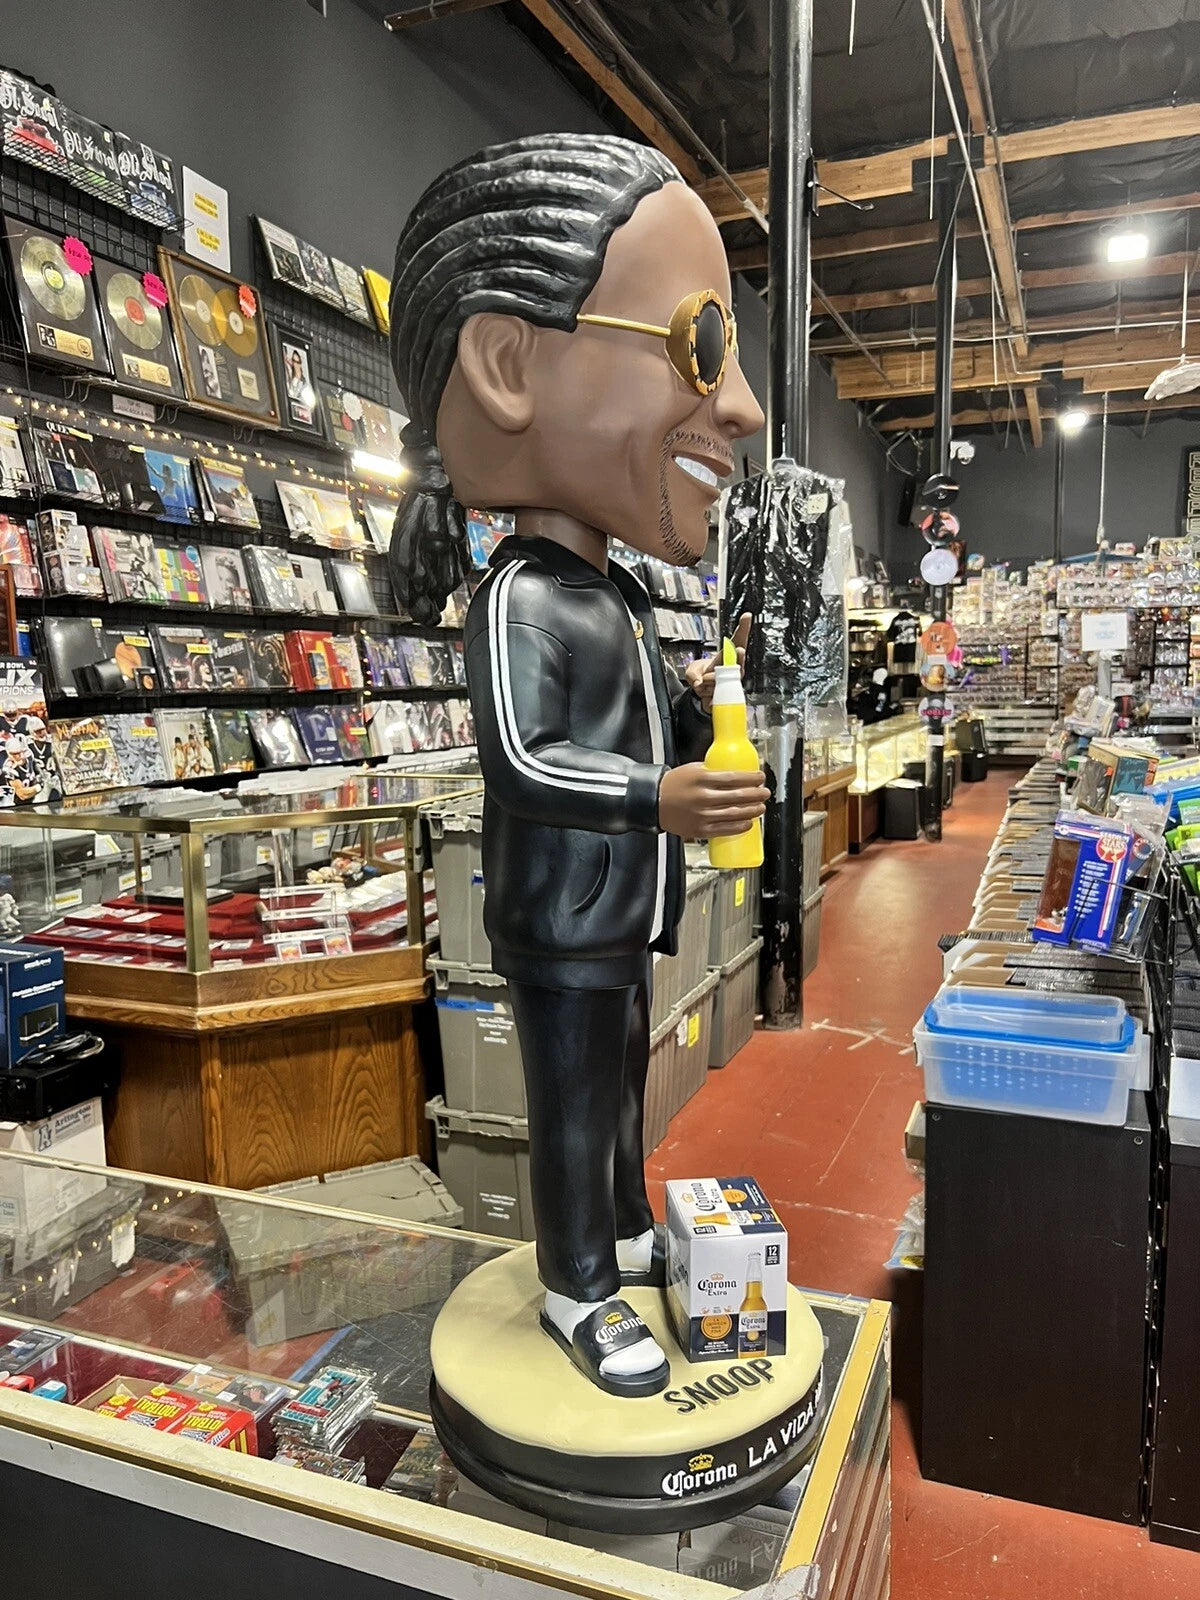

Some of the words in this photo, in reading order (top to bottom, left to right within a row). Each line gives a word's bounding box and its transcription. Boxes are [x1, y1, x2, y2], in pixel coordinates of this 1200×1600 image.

[0, 686, 34, 695] PIONS
[768, 1246, 778, 1256] 12
[697, 1279, 737, 1292] Corona
[707, 1288, 728, 1297] Extra
[595, 1316, 645, 1345] Corona
[664, 1358, 774, 1414] SNOOP
[132, 1397, 181, 1418] FOOTBALL
[182, 1414, 224, 1431] OTBALL
[210, 1427, 231, 1446] dition
[661, 1463, 738, 1497] Corona
[748, 1436, 778, 1468] LA
[780, 1401, 814, 1446] VIDA
